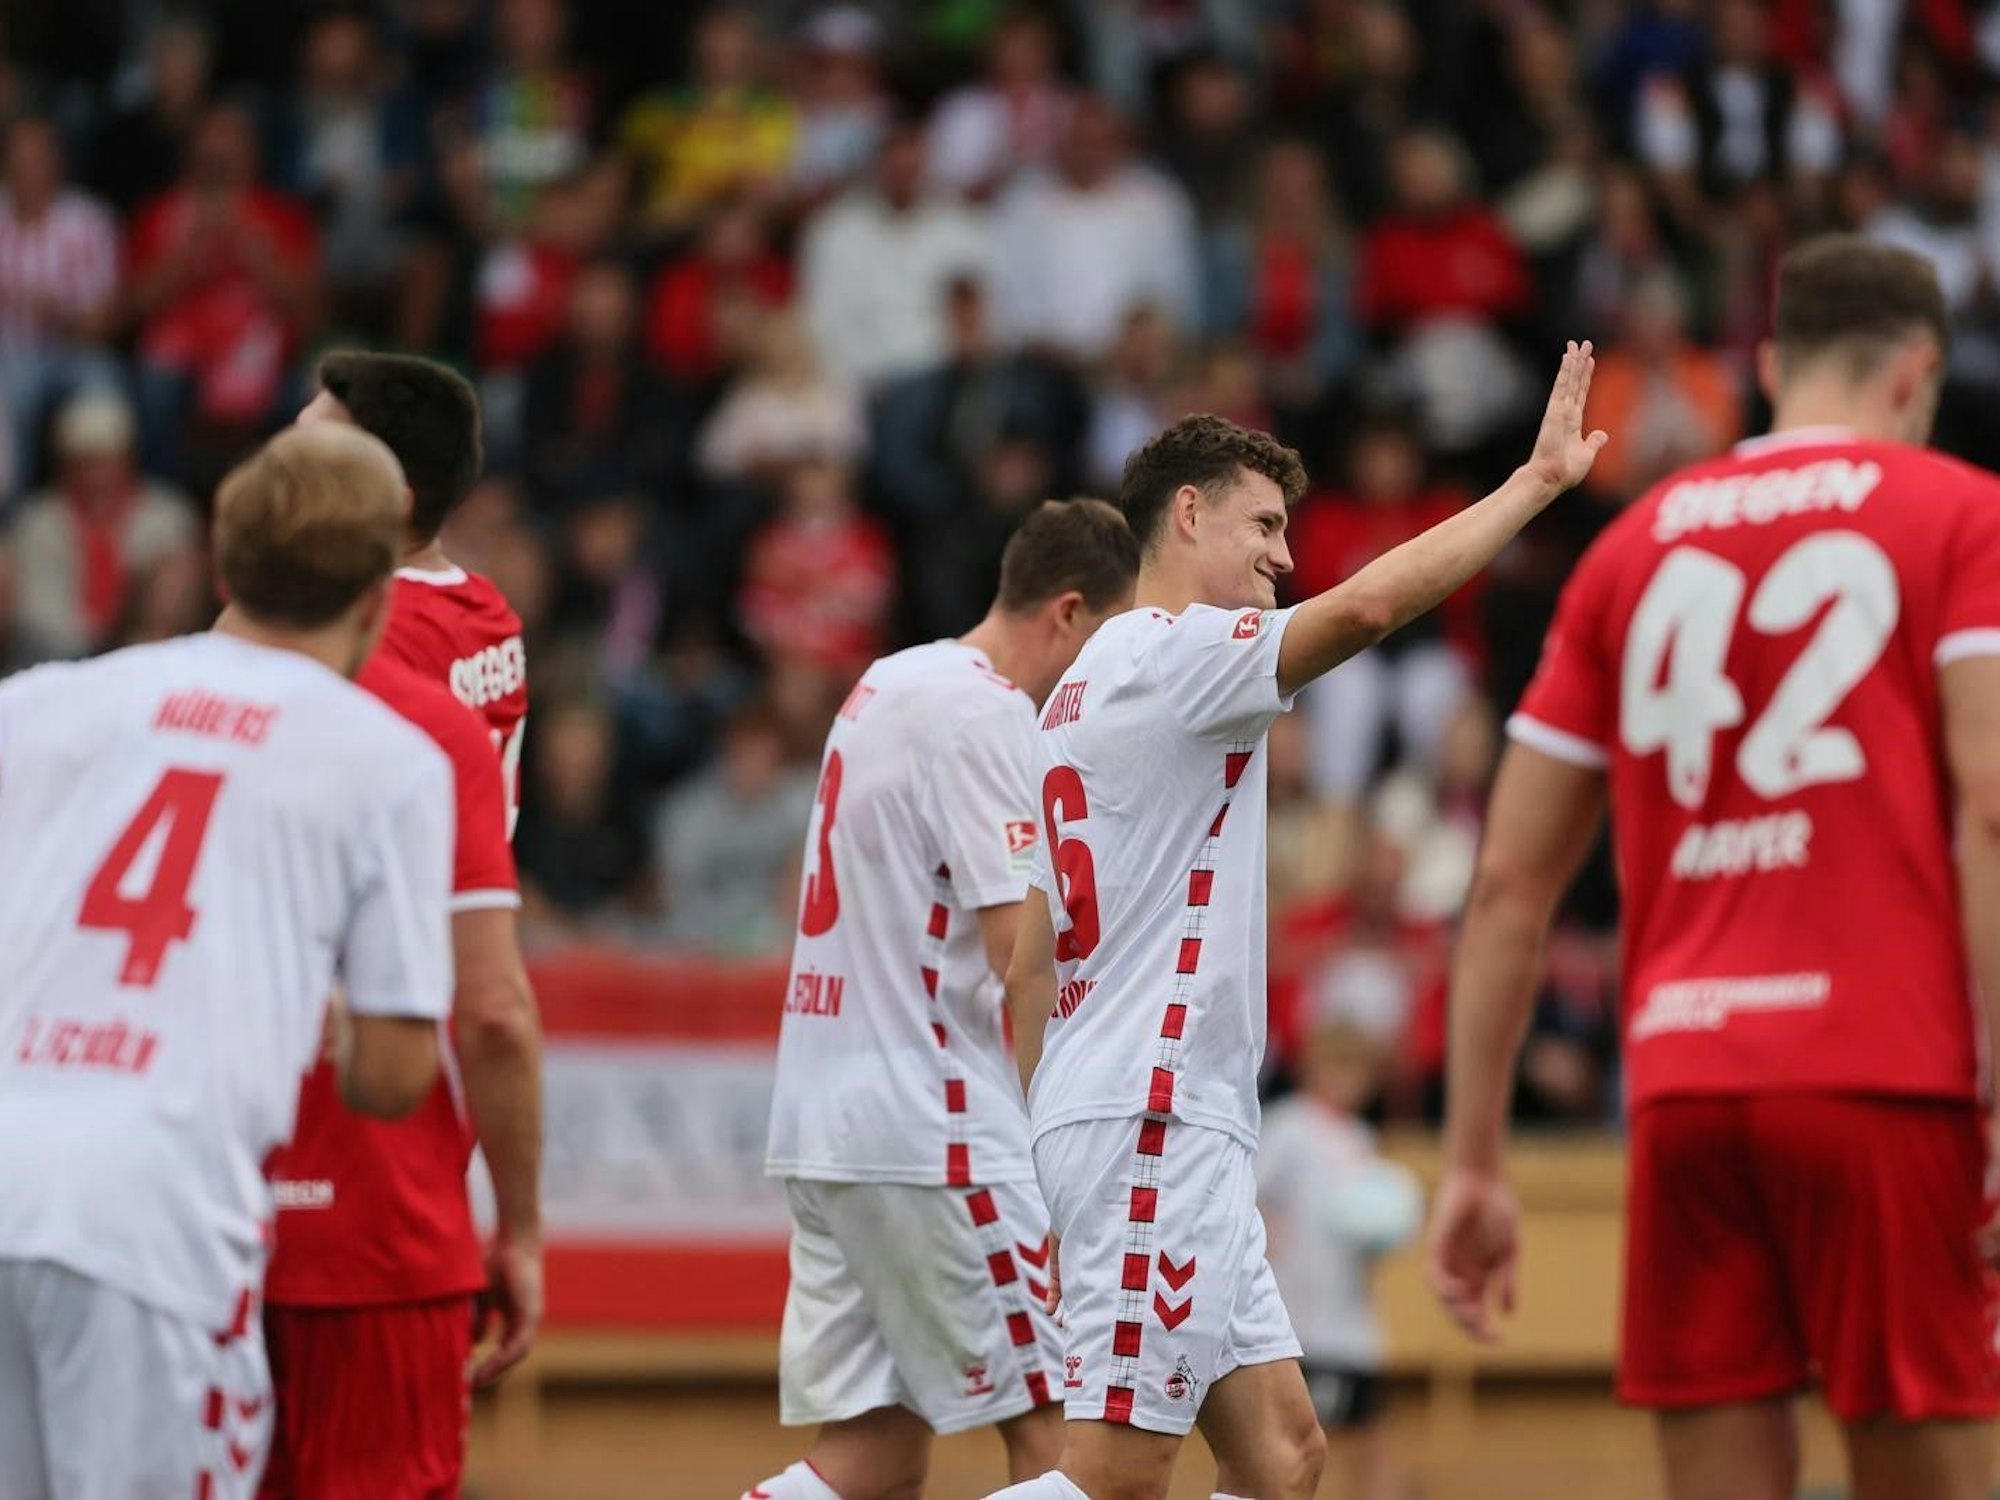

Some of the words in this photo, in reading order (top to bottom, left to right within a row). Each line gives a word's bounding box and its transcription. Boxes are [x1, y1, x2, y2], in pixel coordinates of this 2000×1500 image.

[1653, 458, 1884, 544] SIEGEN
[449, 634, 526, 710] SIEGE
[1619, 528, 1901, 812] 42
[78, 767, 224, 988] 4
[1042, 765, 1100, 963] 6
